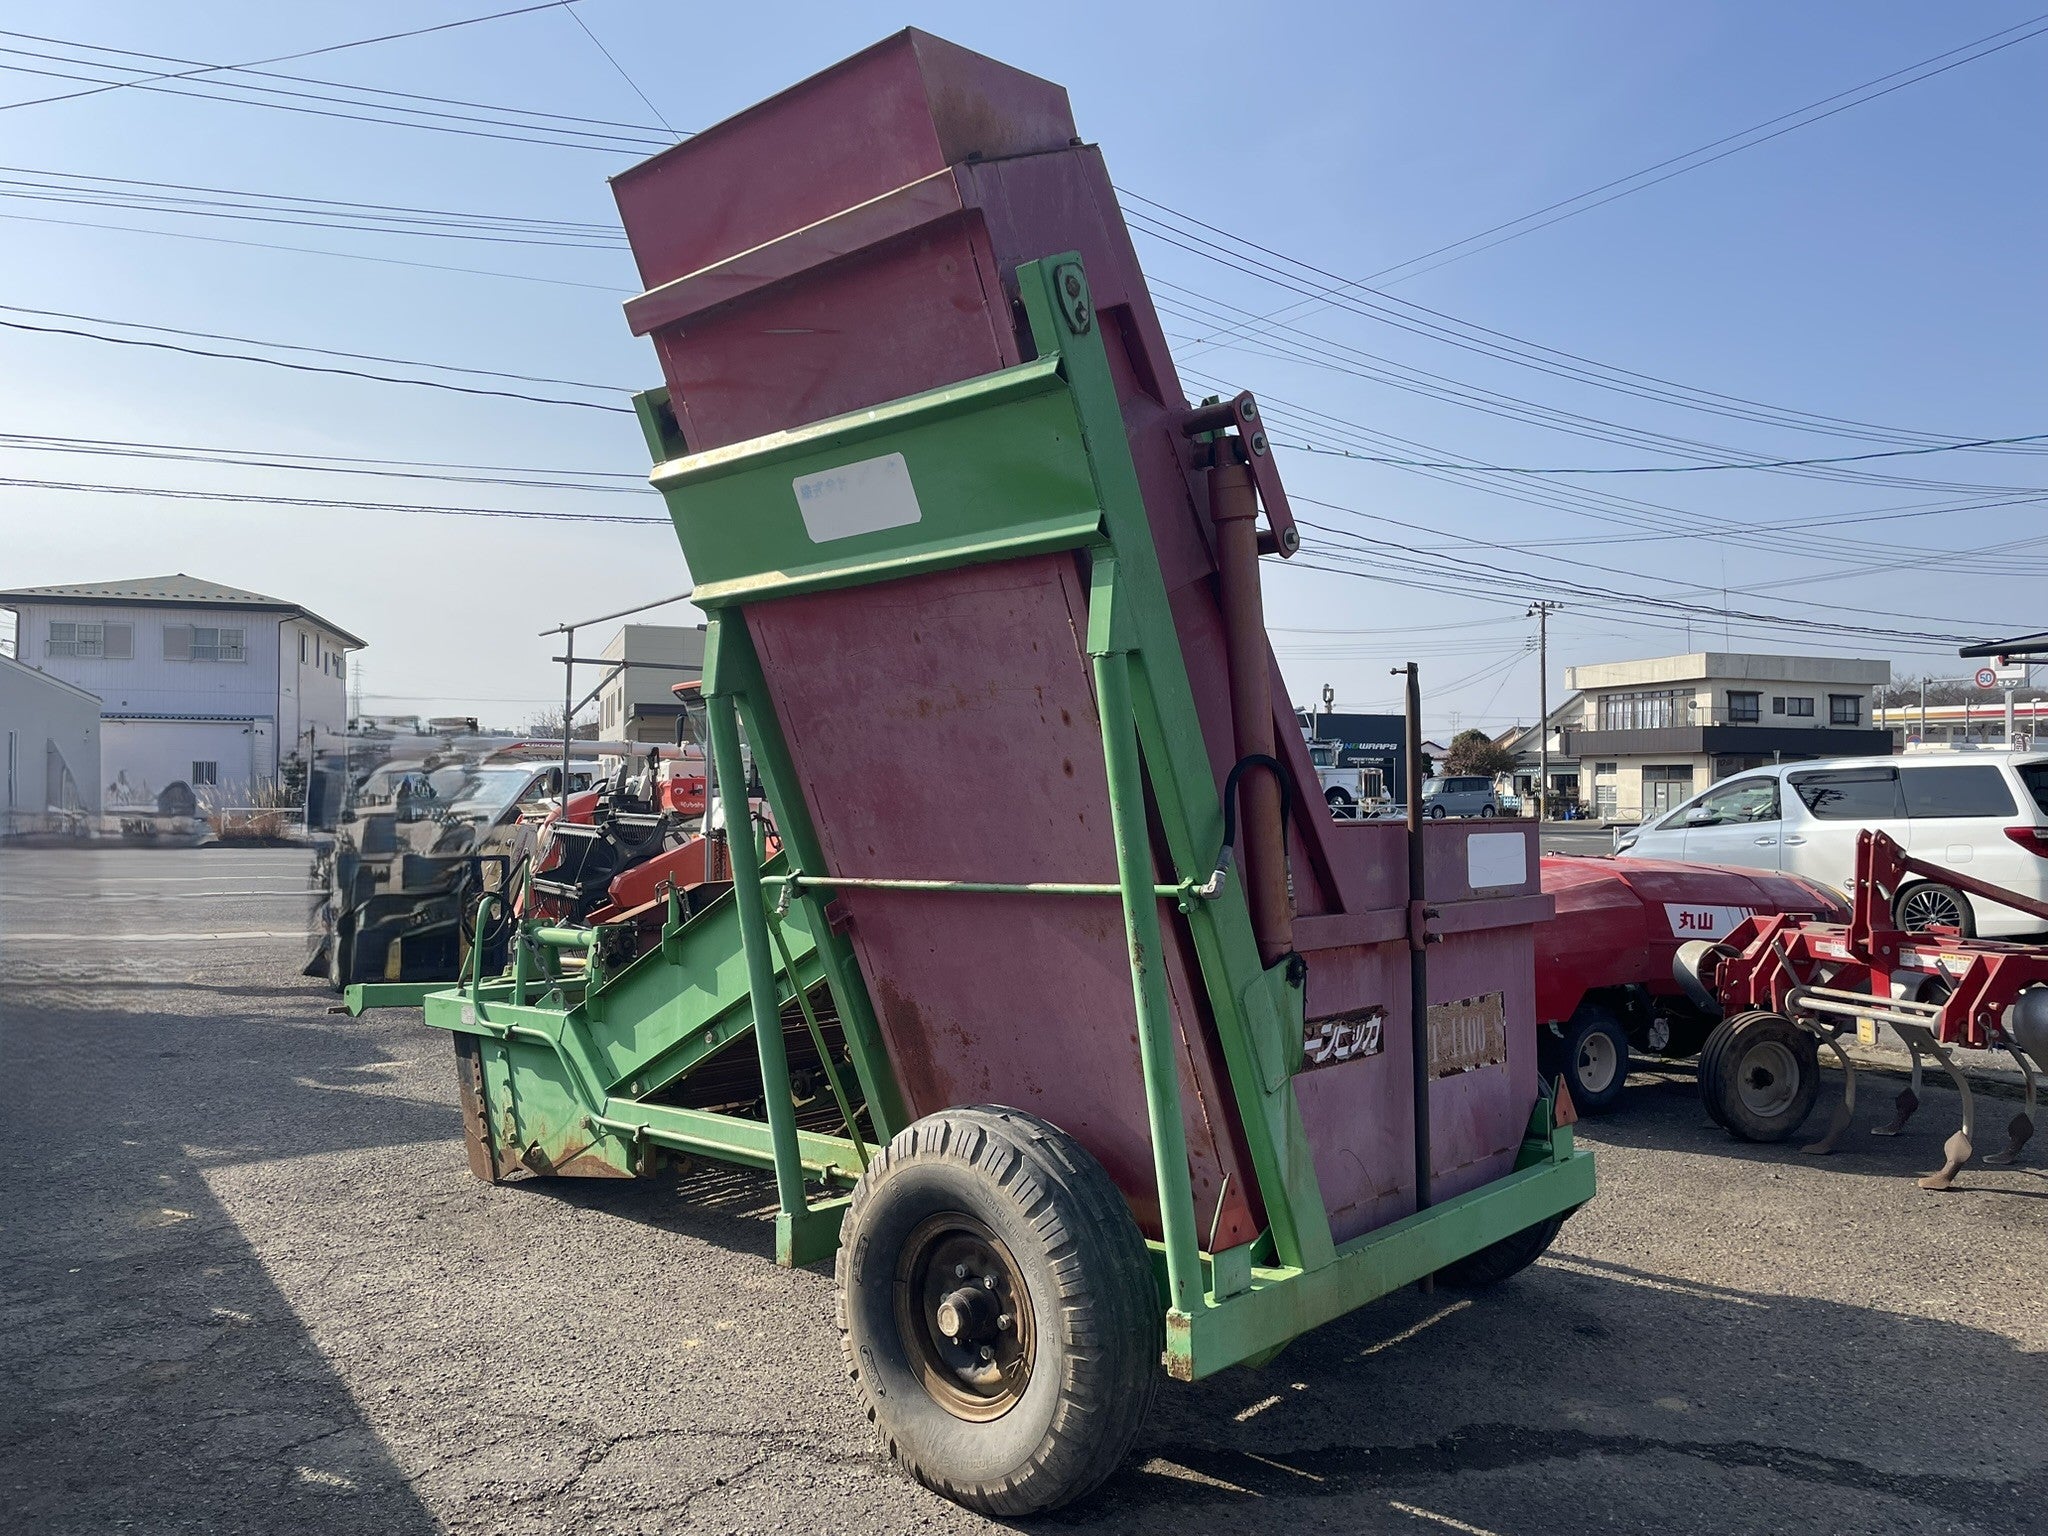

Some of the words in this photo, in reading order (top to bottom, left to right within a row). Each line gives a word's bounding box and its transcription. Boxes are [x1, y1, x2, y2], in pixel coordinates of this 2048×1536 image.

[1980, 673, 1992, 683] 50
[1997, 679, 2018, 687] セルフ
[1679, 911, 1713, 930] 丸山
